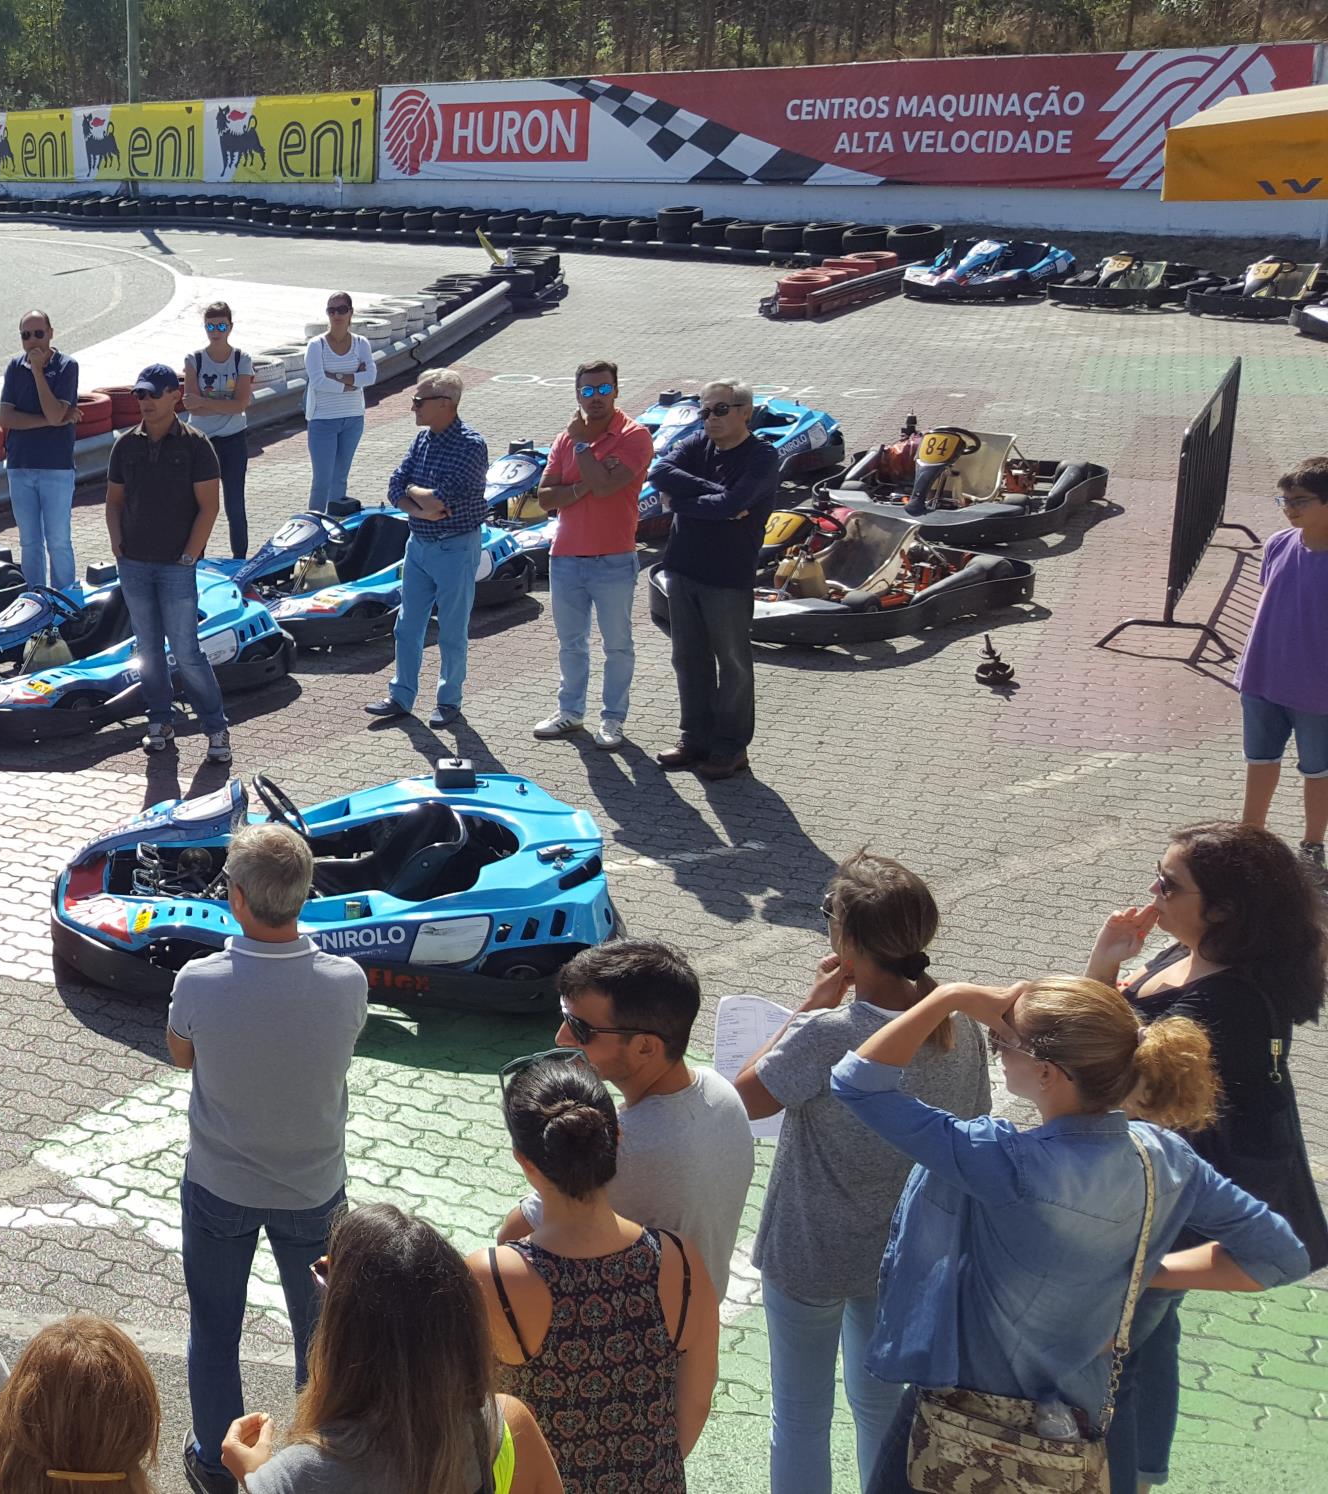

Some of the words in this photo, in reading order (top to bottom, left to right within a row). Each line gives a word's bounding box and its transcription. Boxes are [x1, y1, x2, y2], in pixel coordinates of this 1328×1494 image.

[785, 96, 889, 121] CENTROS
[895, 85, 1085, 123] MAQUINAÇÃO
[128, 106, 195, 177] eni
[278, 97, 363, 178] eni
[452, 108, 578, 155] HURON
[833, 131, 894, 154] ALTA
[902, 130, 1073, 154] VELOCIDADE
[21, 114, 67, 178] eni
[925, 436, 948, 457] 84
[500, 461, 523, 480] 15
[276, 522, 307, 543] 27
[765, 515, 793, 538] 81
[312, 925, 406, 950] CNIROLO
